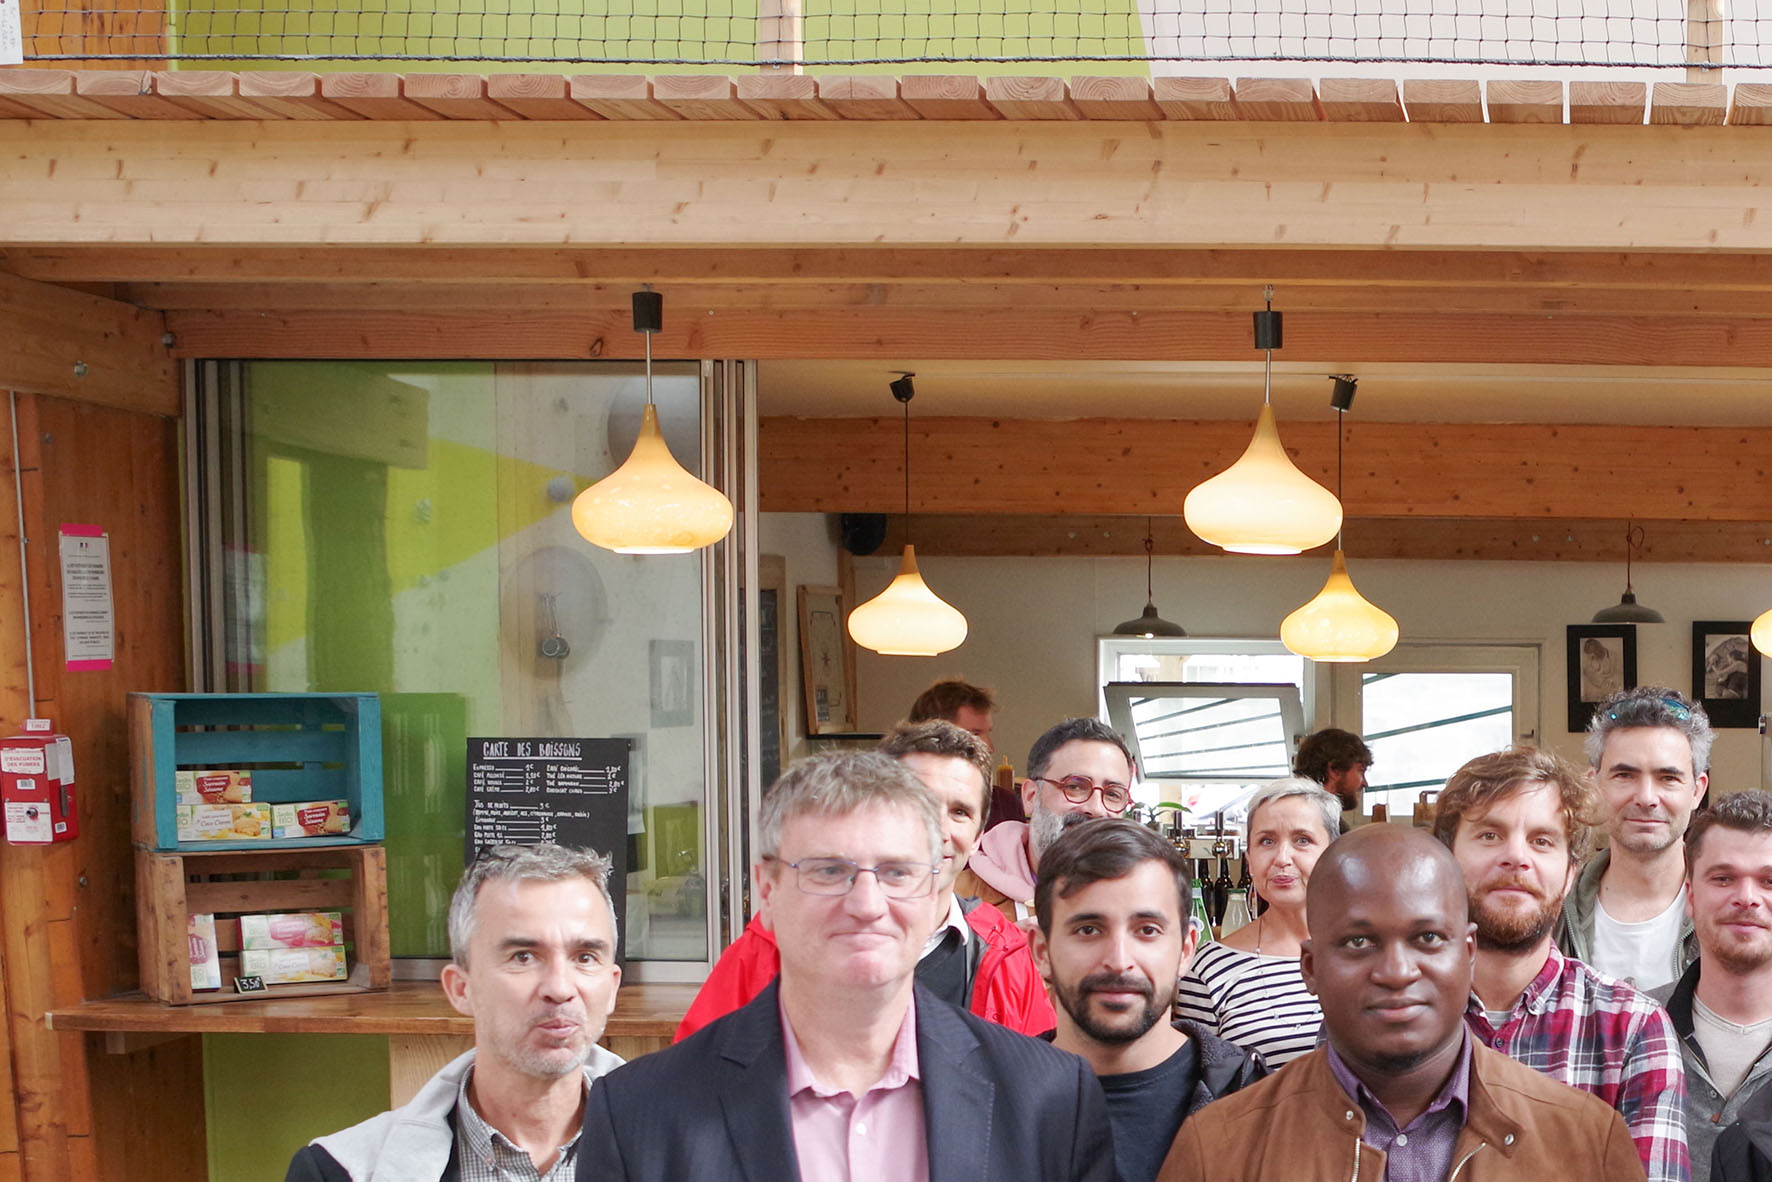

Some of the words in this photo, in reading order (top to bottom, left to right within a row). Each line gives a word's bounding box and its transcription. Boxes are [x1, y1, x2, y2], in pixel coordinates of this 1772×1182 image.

[483, 742, 509, 757] CARTE
[517, 742, 531, 757] DES
[539, 741, 581, 757] BOISSONS
